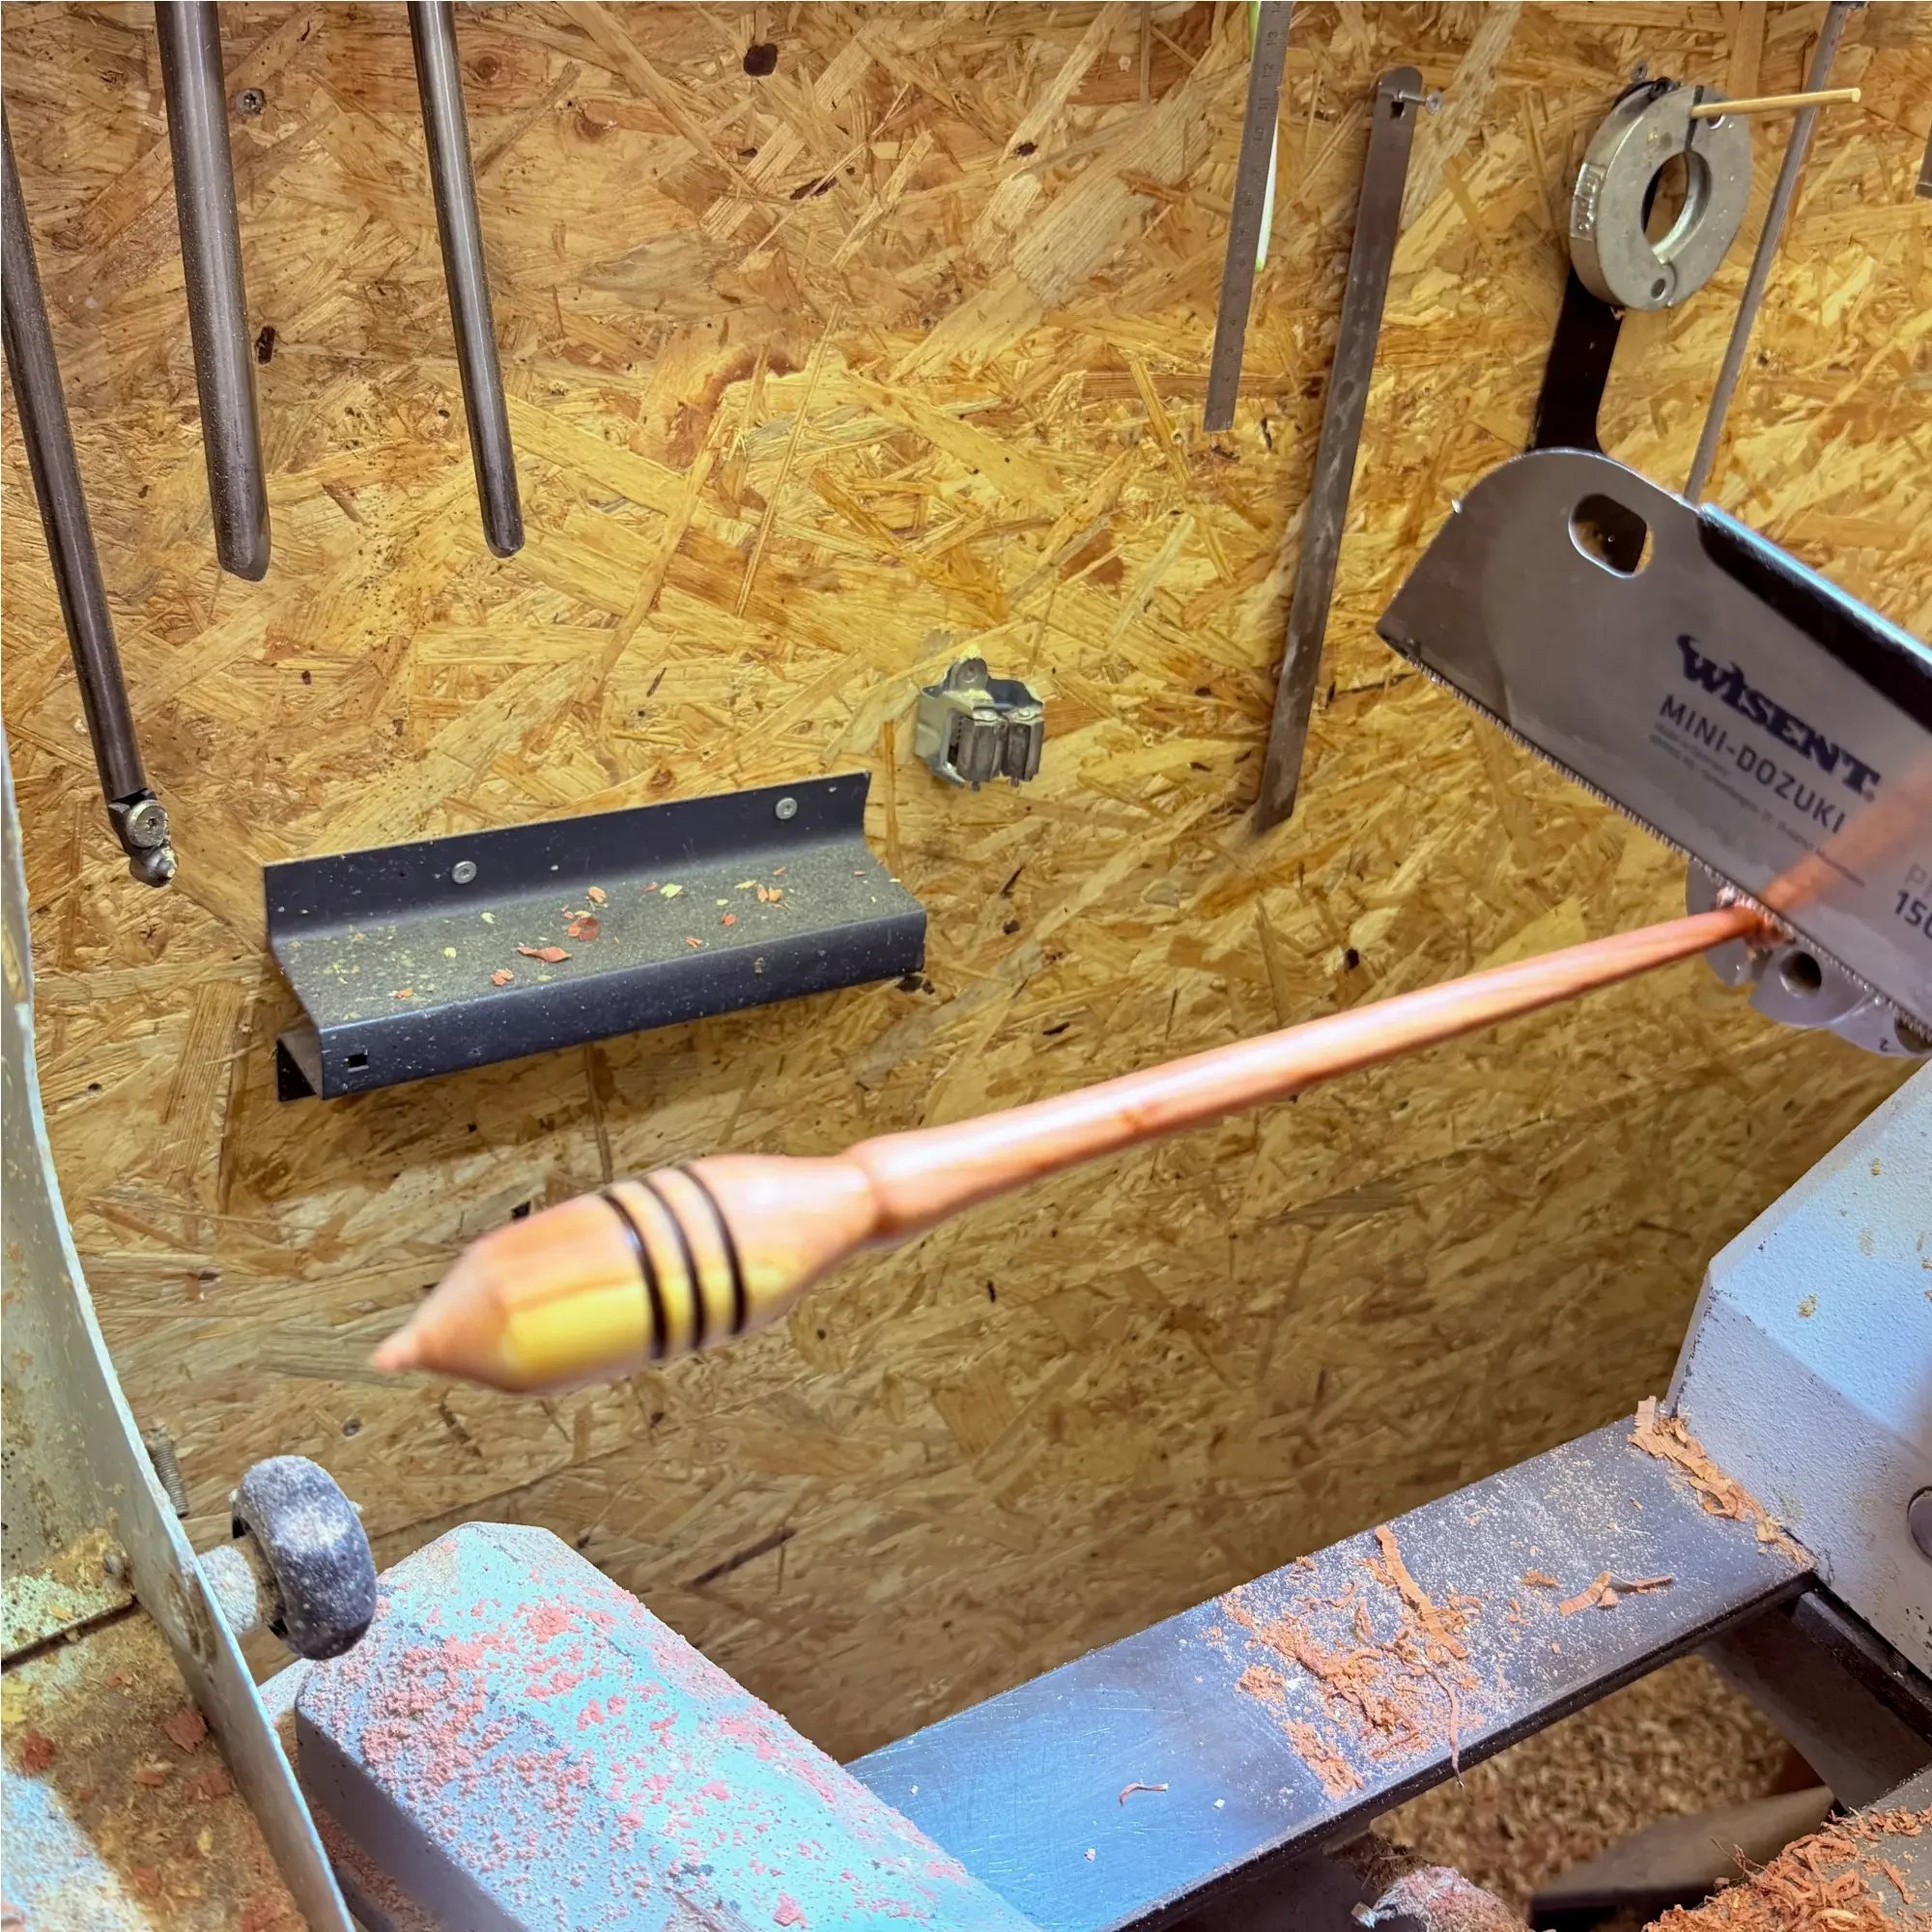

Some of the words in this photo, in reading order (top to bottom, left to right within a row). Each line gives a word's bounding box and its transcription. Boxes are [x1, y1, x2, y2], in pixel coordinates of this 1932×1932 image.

[1266, 30, 1279, 47] 13
[1660, 695, 1847, 835] MINI-DOZUKI
[1676, 634, 1882, 797] WISENT
